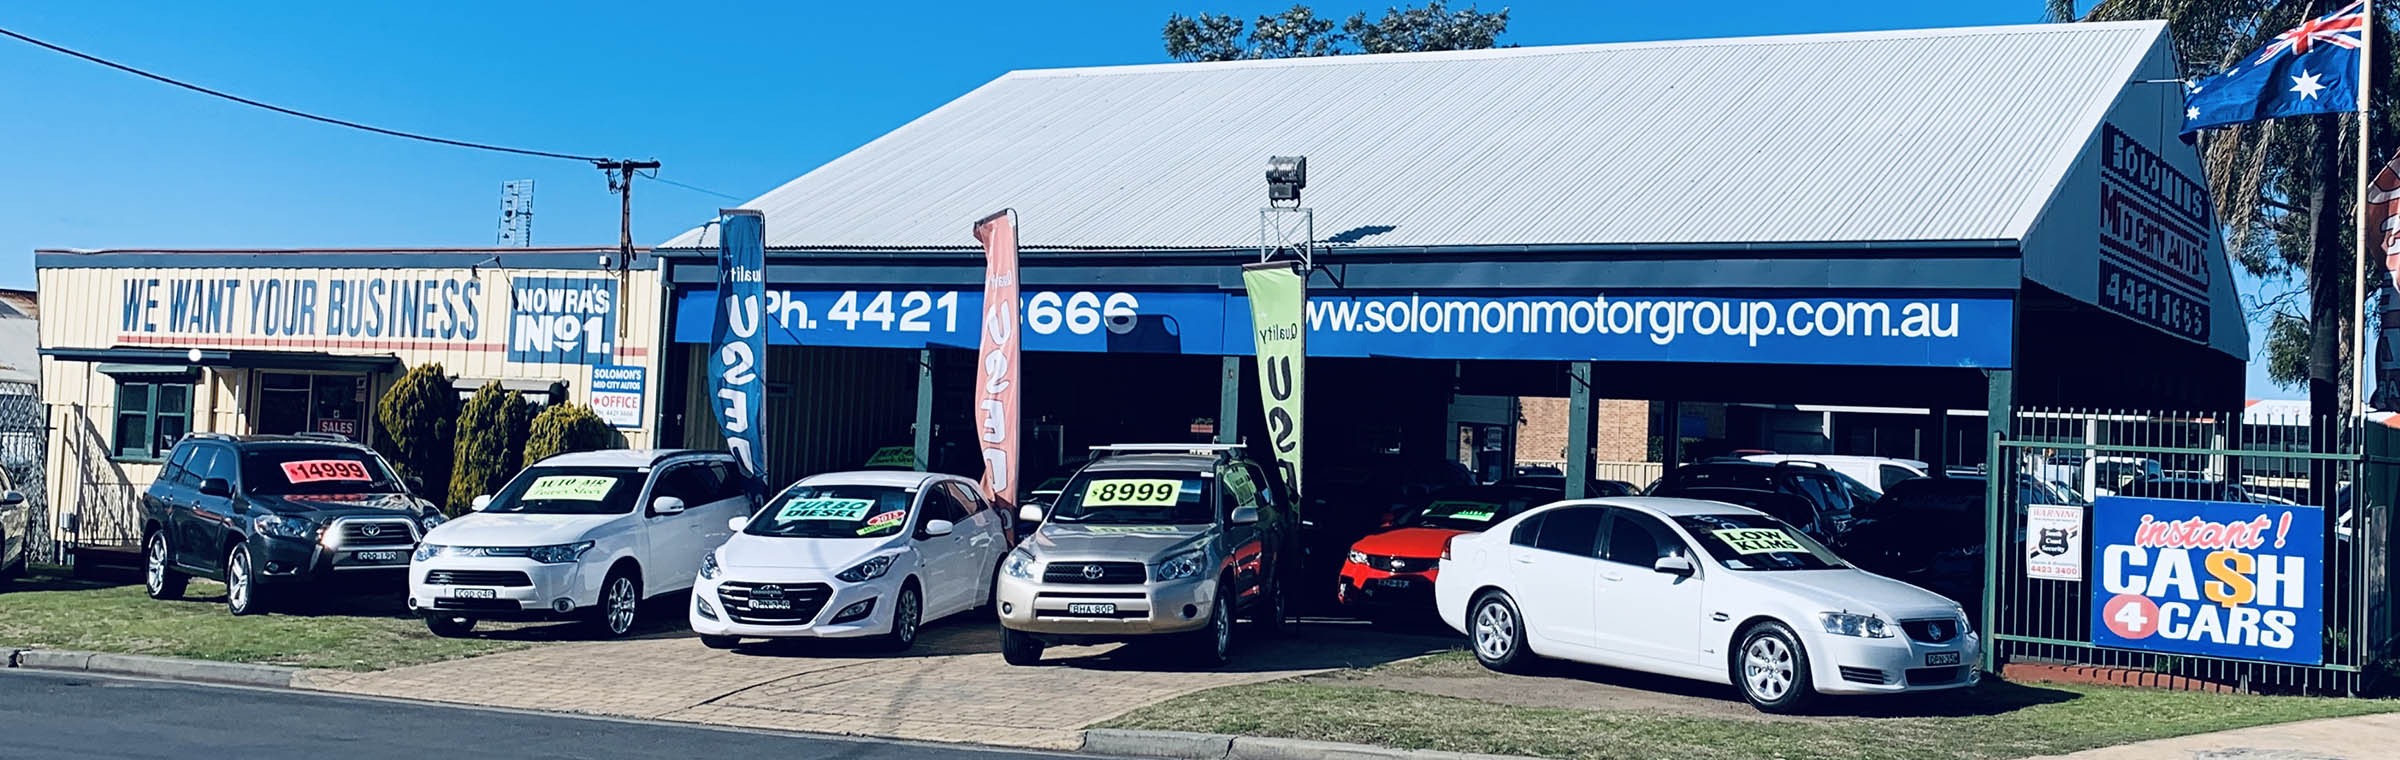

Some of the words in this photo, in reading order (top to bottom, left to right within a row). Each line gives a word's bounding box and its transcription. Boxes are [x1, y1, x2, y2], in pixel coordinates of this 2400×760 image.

[517, 283, 610, 314] NOWRA'S
[2106, 272, 2156, 320] 4421
[122, 279, 160, 332] WE
[170, 279, 240, 334] WANT
[250, 278, 317, 336] YOUR
[327, 278, 480, 340] BUSINESS
[828, 290, 958, 332] 4421
[1020, 291, 1139, 335] 666
[1306, 293, 1959, 347] ww.solomonmotorgroup.com.au
[594, 368, 641, 380] SOLOMON'S
[606, 381, 620, 389] CITY
[620, 382, 640, 390] AUTOS
[601, 395, 638, 409] OFFICE
[321, 421, 353, 433] SALES
[790, 501, 867, 510] TURBO
[785, 509, 857, 518] DIESEL
[2033, 509, 2078, 519] WARNING
[1720, 531, 1782, 541] LOW
[1735, 540, 1799, 550] KLMS
[2114, 602, 2148, 632] 4
[2157, 602, 2297, 649] CARS
